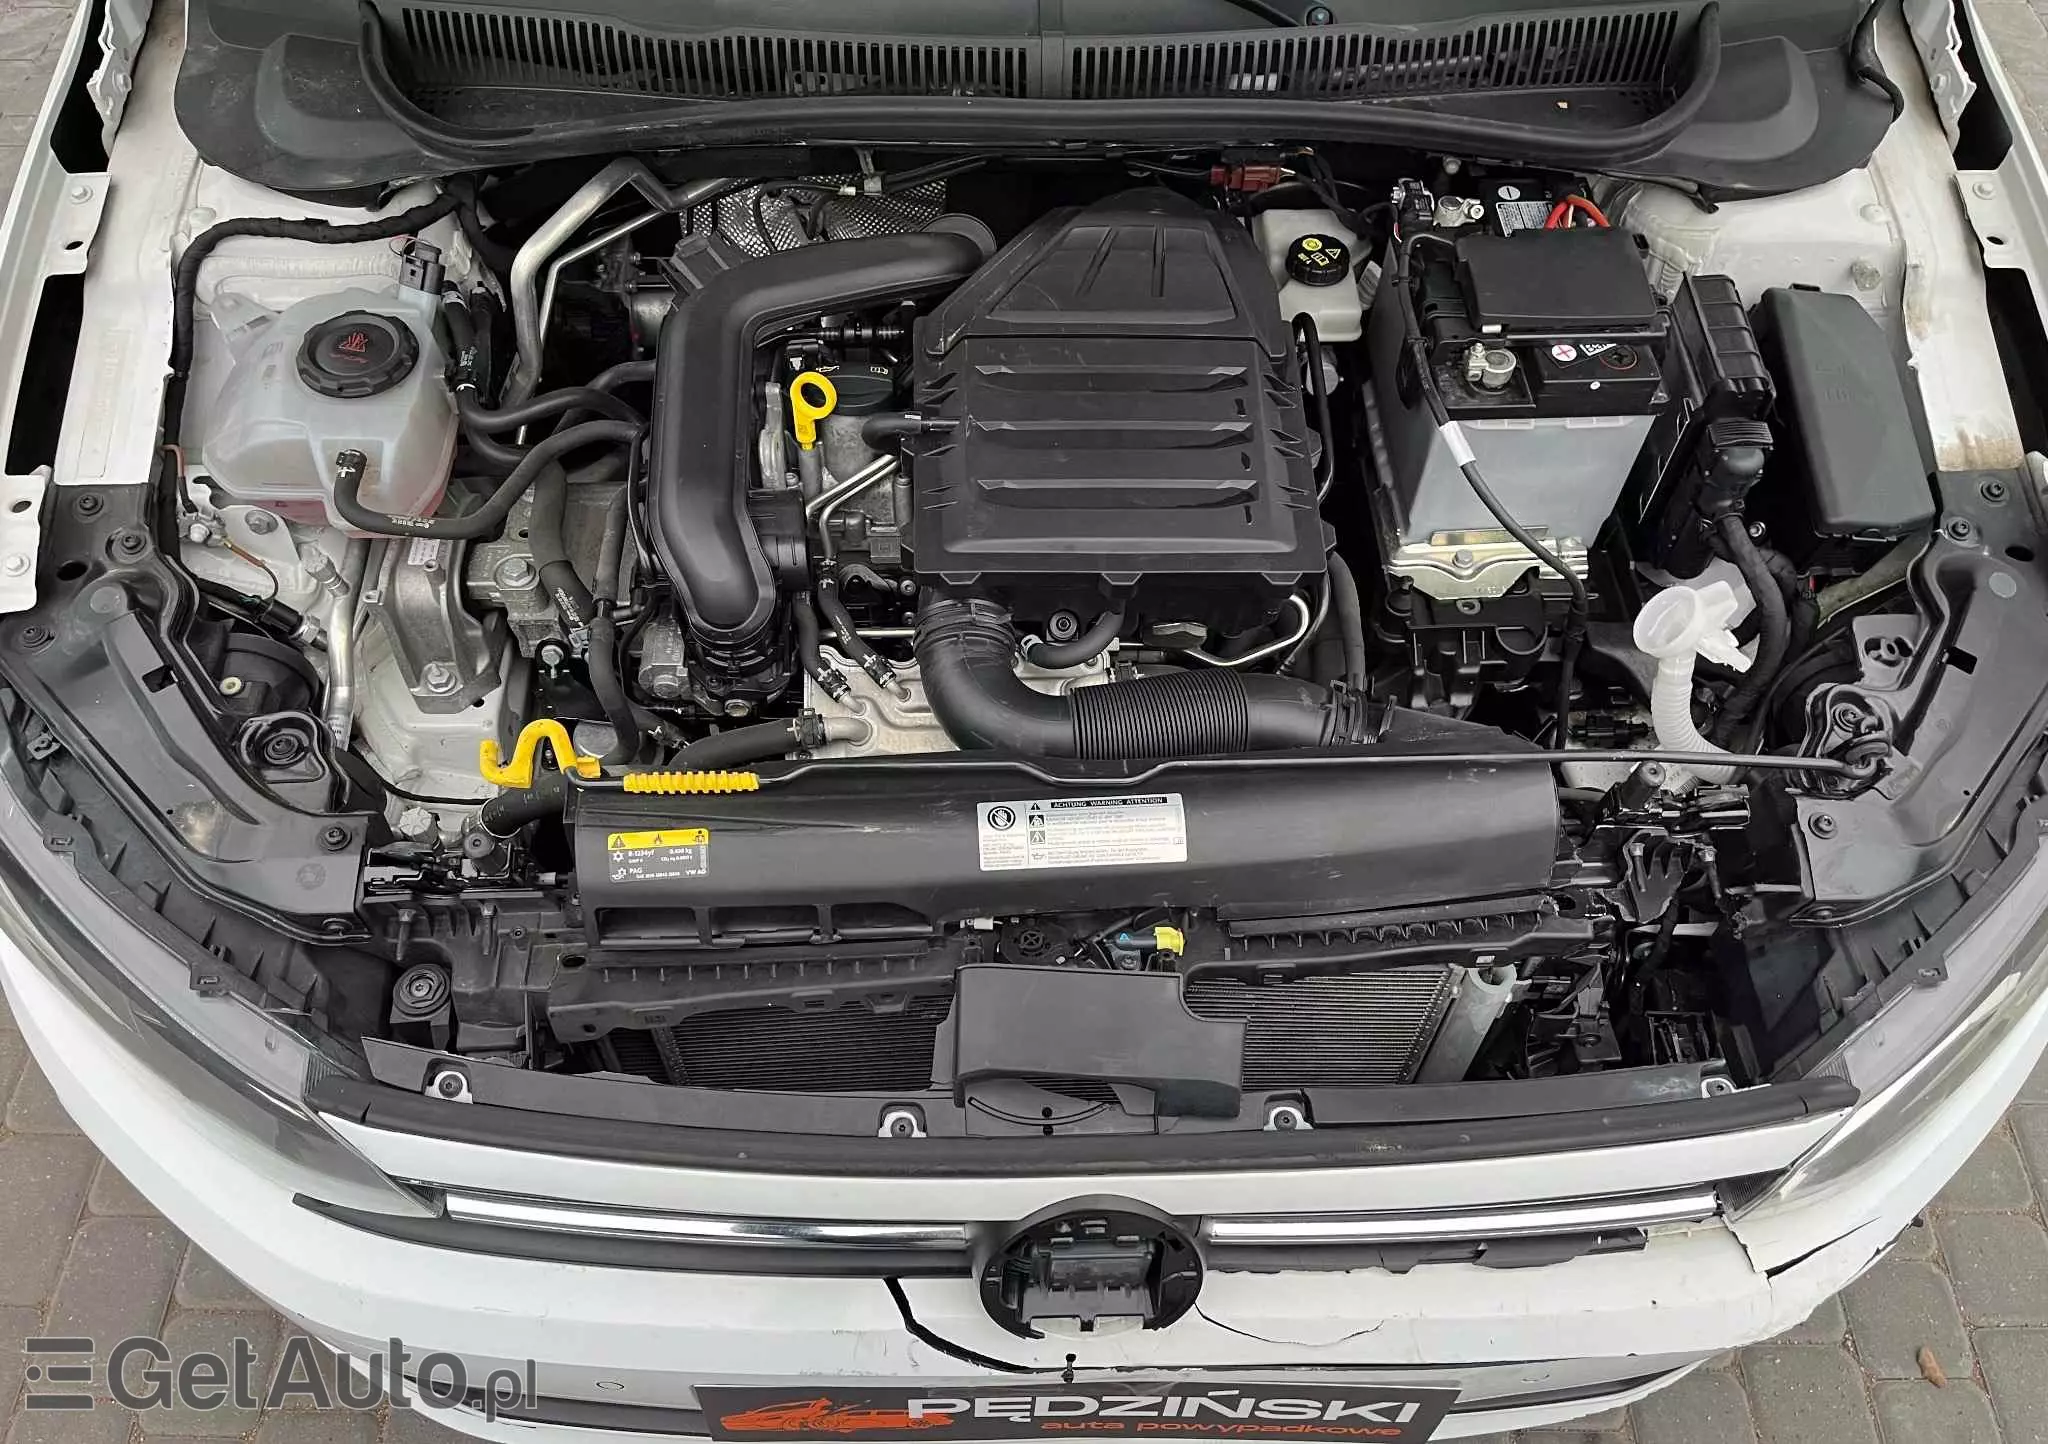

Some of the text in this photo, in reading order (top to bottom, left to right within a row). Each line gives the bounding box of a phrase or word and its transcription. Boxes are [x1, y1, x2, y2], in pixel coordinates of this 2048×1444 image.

[1053, 801, 1087, 809] ACHTUNG
[1126, 797, 1163, 805] ATTENTION
[908, 1389, 1420, 1423] PĘDZIŃSKI
[1040, 1420, 1402, 1435] auta powypadkowe
